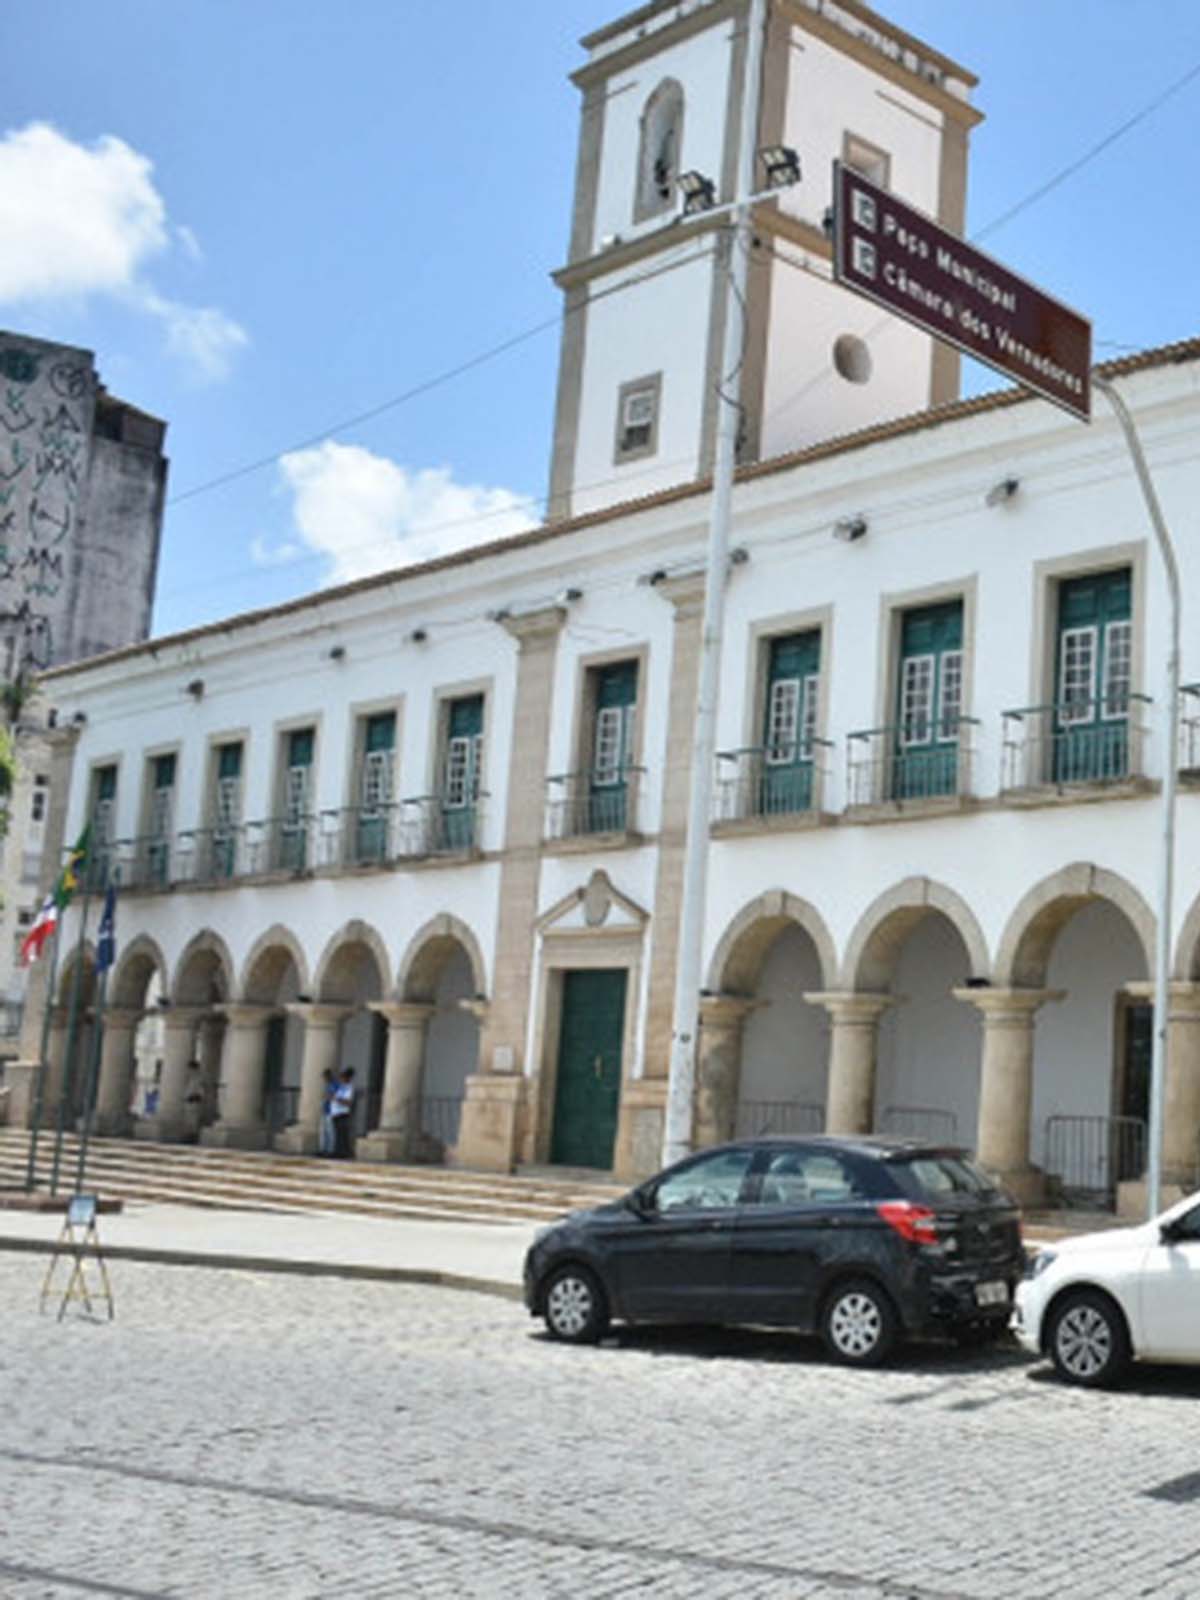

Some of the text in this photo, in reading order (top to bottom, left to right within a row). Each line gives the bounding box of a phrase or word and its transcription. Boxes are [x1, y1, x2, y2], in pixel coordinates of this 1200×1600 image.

[883, 213, 1017, 313] Paço Municipal
[882, 262, 1083, 394] Câmara dos Vereadores
